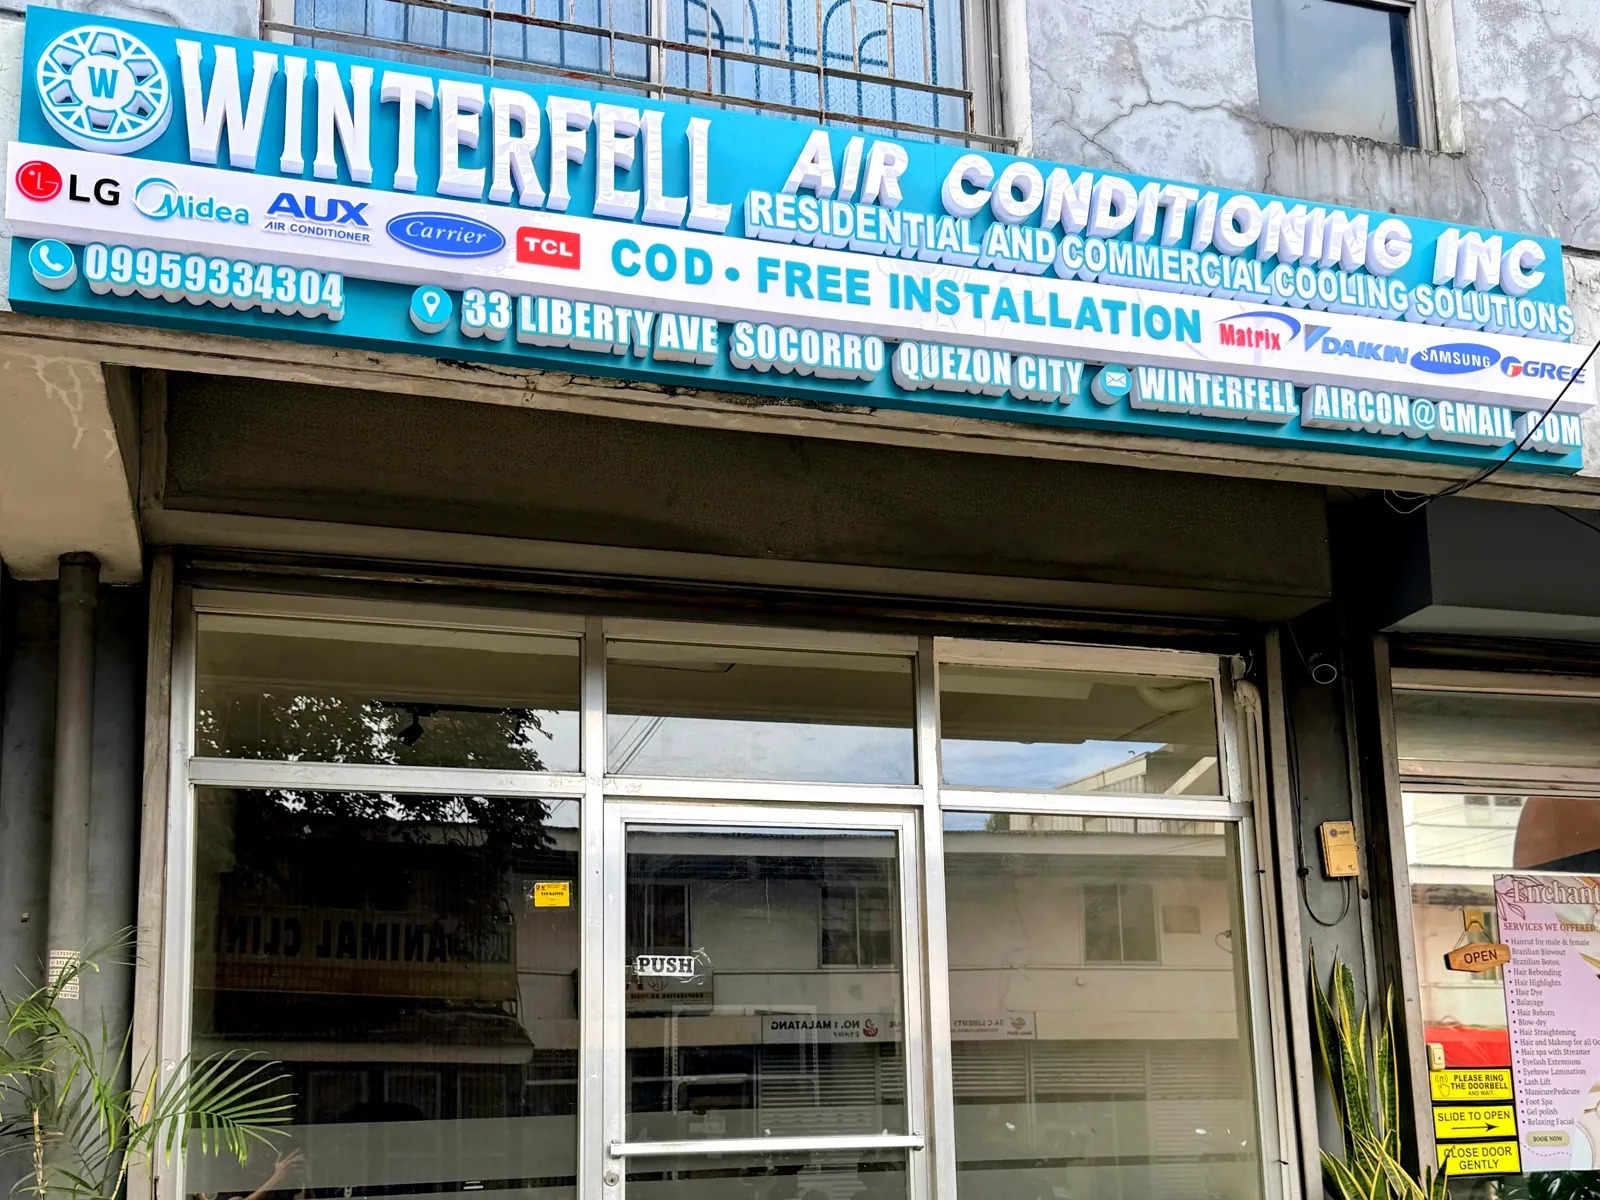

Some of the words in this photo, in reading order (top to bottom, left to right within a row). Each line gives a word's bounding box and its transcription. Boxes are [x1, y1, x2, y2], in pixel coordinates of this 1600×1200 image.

[88, 66, 119, 99] W
[175, 38, 732, 230] WINTERFELL
[69, 173, 120, 206] LG
[146, 186, 250, 226] Midea
[266, 192, 371, 228] AUX
[782, 129, 908, 205] AIR
[943, 154, 1412, 273] CONDITIONING
[1435, 228, 1545, 294] INC
[263, 220, 286, 232] AIR
[289, 223, 371, 244] CONDITIONER
[404, 220, 488, 245] Carrier
[523, 237, 573, 257] TCL
[748, 190, 980, 258] RESIDENTIAL
[987, 222, 1056, 266] AND
[1062, 234, 1270, 297] COMMERCIAL
[1275, 264, 1408, 312] COOLING
[1415, 286, 1575, 337] SOLUTIONS
[84, 242, 344, 310] 09959334304
[611, 238, 714, 285] COD
[757, 256, 871, 306] FREE
[889, 272, 1201, 344] INSTALLATION
[462, 287, 512, 331] 33
[518, 294, 654, 349] LIBERTY
[656, 312, 719, 354] AVE
[734, 320, 886, 373] SOCORRO
[898, 340, 1012, 387] QUEZON
[1016, 356, 1084, 395] CITY
[1219, 322, 1281, 351] Matrix
[1321, 338, 1409, 364] DAIKIN
[1420, 348, 1490, 369] SAMSUNG
[1522, 360, 1586, 384] GREE
[1137, 366, 1299, 415] WINTERFELL
[1503, 922, 1543, 931] SERVICES
[1544, 923, 1558, 931] WE
[1560, 923, 1598, 932] OFFERED:
[1545, 938, 1561, 946] male
[1464, 949, 1498, 964] OPEN
[638, 957, 693, 973] PUSH
[1513, 968, 1527, 976] Hair
[1528, 968, 1562, 977] Rebonding
[1529, 979, 1562, 987] Highlights
[1515, 988, 1529, 996] Hair
[1530, 988, 1543, 997] Dye
[1516, 998, 1544, 1007] Balayage
[1518, 1018, 1547, 1027] Blow-dry
[1519, 1028, 1533, 1036] Hair
[1534, 1028, 1576, 1037] Straightening
[1520, 1038, 1534, 1046] Hair
[1535, 1038, 1547, 1046] and
[1548, 1038, 1572, 1047] Makeup
[1573, 1038, 1583, 1046] for
[1583, 1038, 1592, 1046] all
[1521, 1048, 1535, 1056] Hair
[1536, 1049, 1547, 1057] spa
[1548, 1048, 1562, 1056] with
[1563, 1048, 1591, 1056] Streamer
[1522, 1058, 1547, 1066] Eyelash
[1547, 1058, 1581, 1066] Extensions
[1523, 1068, 1550, 1076] Eyebrow
[1468, 1082, 1508, 1090] DOORBELL
[1541, 1098, 1553, 1107] Spa
[1437, 1112, 1466, 1122] SLIDE
[1468, 1111, 1481, 1121] TO
[1484, 1110, 1510, 1120] OPEN
[1526, 1108, 1538, 1116] Gel
[1538, 1108, 1559, 1117] polish
[1527, 1118, 1555, 1127] Relaxing
[1443, 1147, 1479, 1158] CLOSE
[1481, 1146, 1512, 1157] DOOR
[1459, 1159, 1499, 1170] GENTLY
